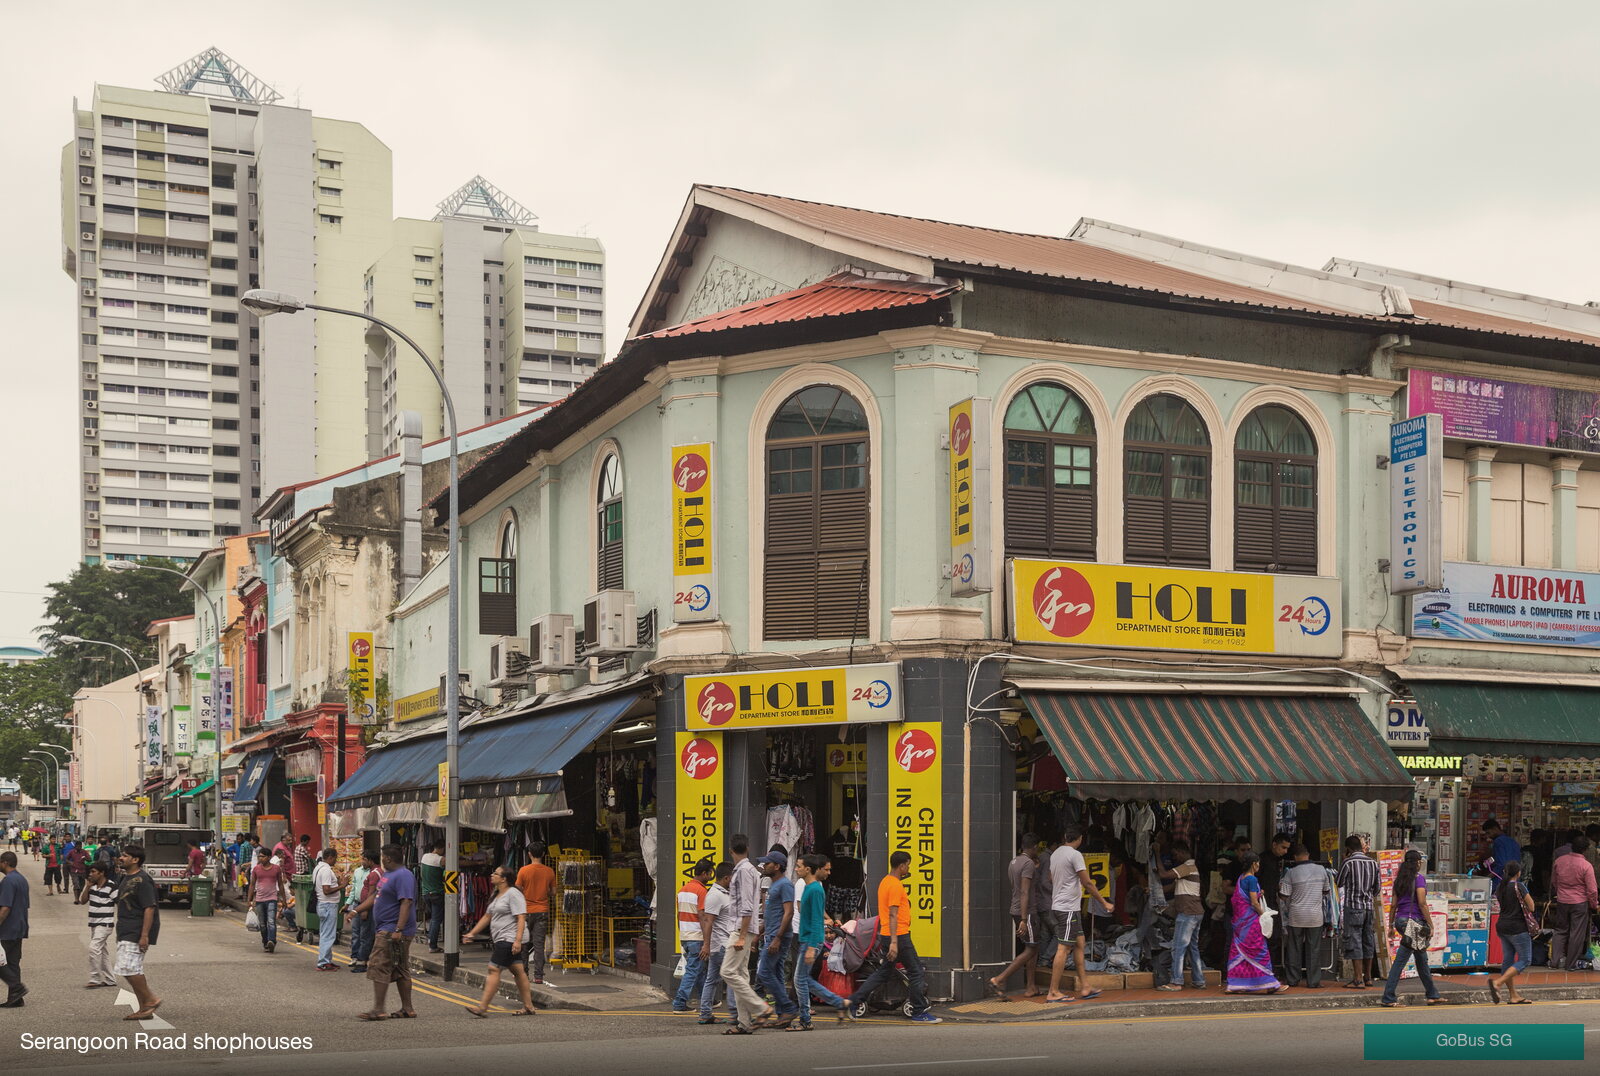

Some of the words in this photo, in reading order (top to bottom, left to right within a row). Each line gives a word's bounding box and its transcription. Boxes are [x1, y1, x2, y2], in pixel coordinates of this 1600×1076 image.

[1391, 418, 1425, 438] AUROMA
[1394, 432, 1423, 446] ELECTRONICS
[1398, 441, 1424, 453] COMPUTERS
[1400, 452, 1408, 460] PTE
[957, 458, 970, 536] HOLI
[1403, 463, 1416, 580] ELETRONICS
[684, 497, 704, 566] HOLI
[953, 561, 964, 578] 24
[1490, 573, 1586, 605] AUROMA
[674, 591, 693, 605] 24
[1116, 581, 1247, 625] HOLI
[1278, 604, 1305, 623] 24
[1468, 602, 1516, 615] ELECTRONICS
[1519, 605, 1527, 616] &
[1530, 606, 1573, 619] COMPUTERS
[1576, 609, 1590, 620] PTE
[1116, 623, 1172, 634] DEPARTMENT
[1174, 625, 1201, 635] STORE
[1304, 617, 1322, 625] Hours
[1463, 616, 1484, 626] MOBILE
[1484, 618, 1506, 627] PHONES
[1508, 620, 1533, 629] LAPTOPS
[1535, 621, 1548, 630] iPAD
[1551, 623, 1576, 633] CAMERAS
[1202, 638, 1224, 646] since
[1227, 638, 1246, 647] 1982
[739, 680, 835, 711] HOLI
[851, 687, 872, 701] 24
[739, 712, 780, 720] DEPARTMENT
[187, 780, 197, 788] 10
[896, 788, 912, 808] IN
[918, 807, 935, 925] CHEAPEST
[1088, 861, 1108, 891] 5
